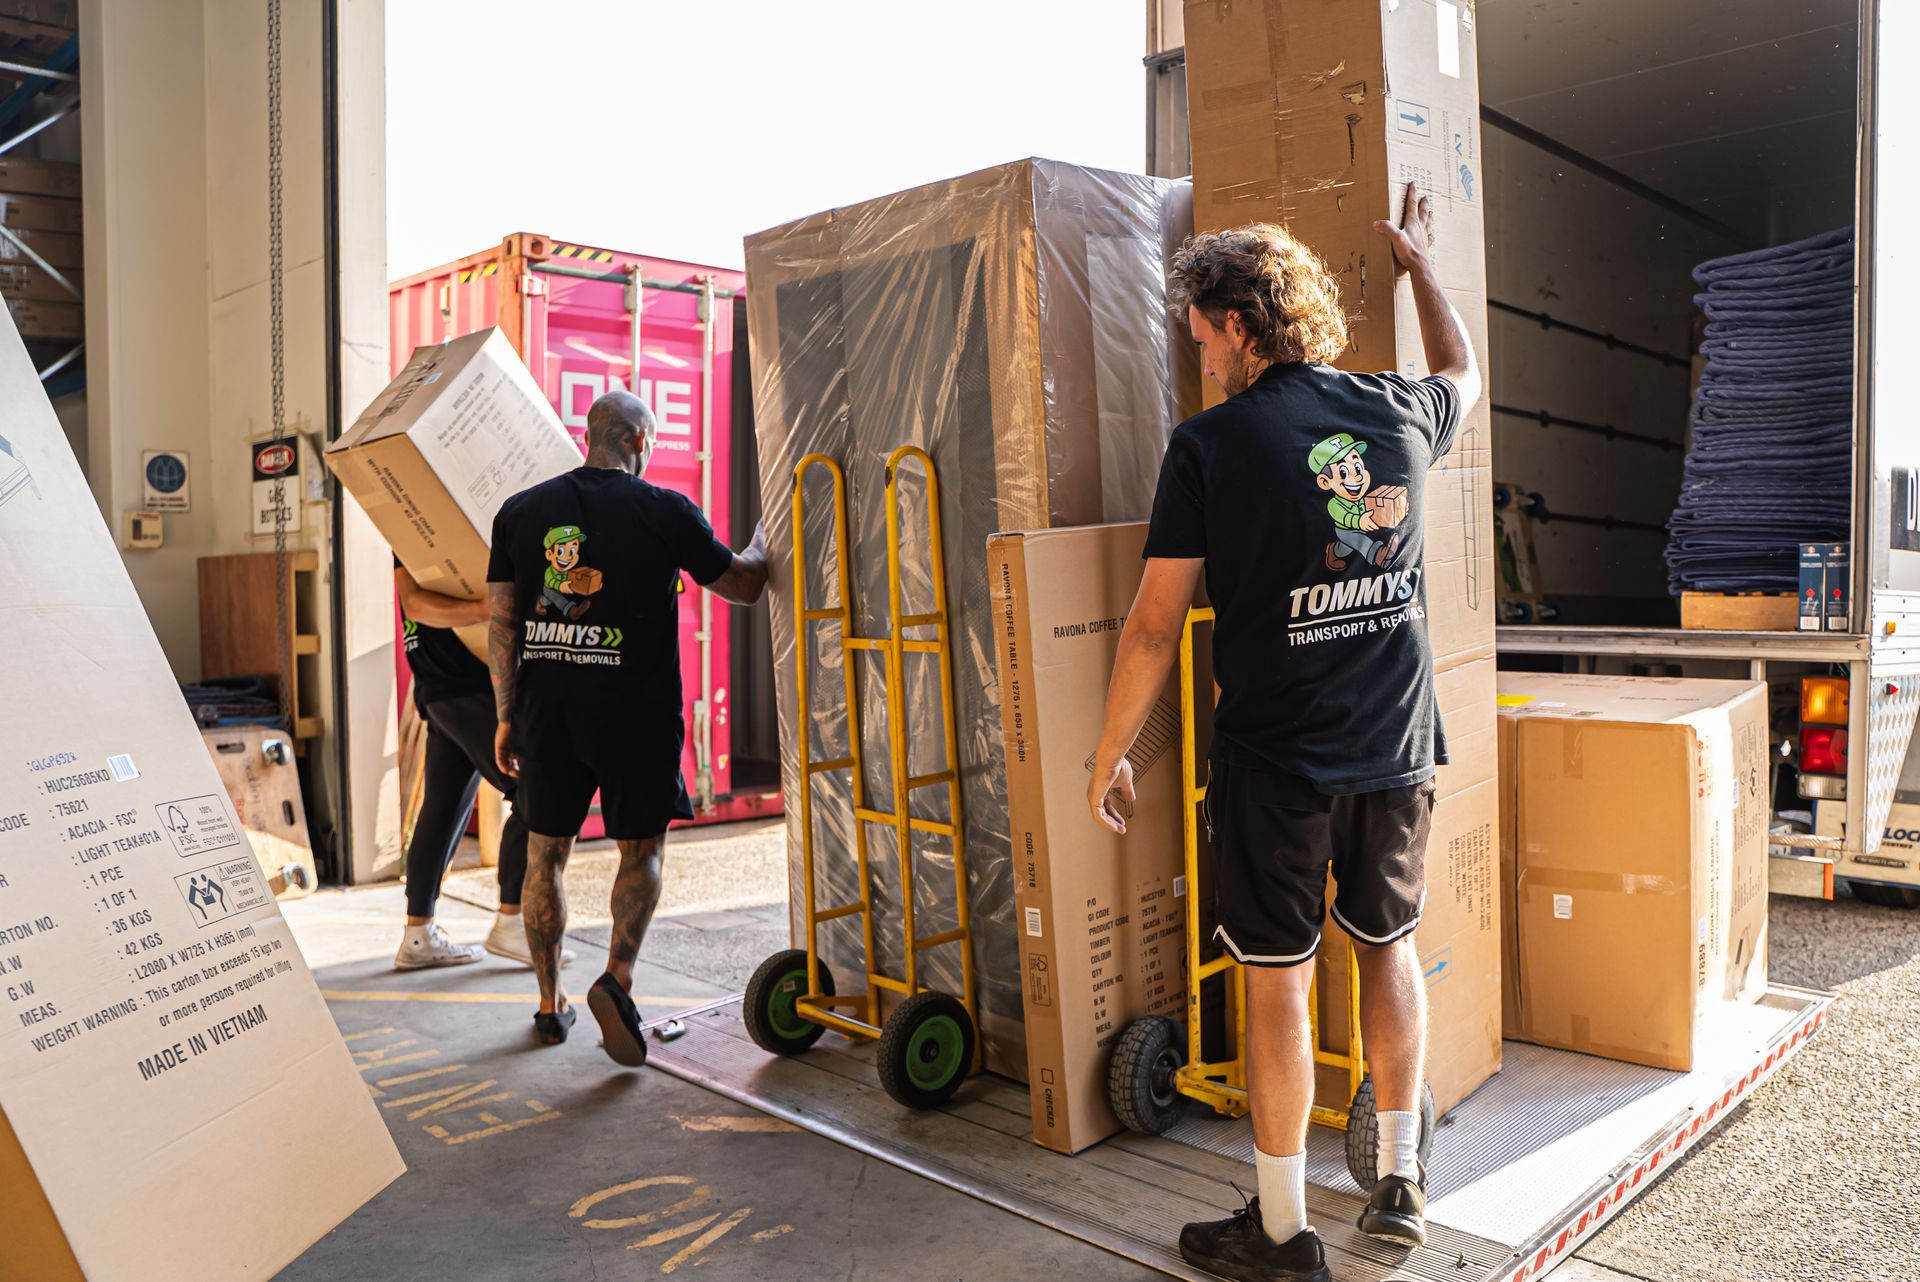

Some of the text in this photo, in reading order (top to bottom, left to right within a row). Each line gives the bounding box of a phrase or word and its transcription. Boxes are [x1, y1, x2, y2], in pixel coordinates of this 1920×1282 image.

[1329, 437, 1343, 448] T
[563, 528, 573, 536] T
[1001, 563, 1012, 601] RAVONA
[1289, 569, 1413, 618] TOMMYS
[1005, 603, 1015, 638] COFFEE
[1054, 622, 1087, 639] RAVONA
[1088, 619, 1118, 634] COFFEE
[1288, 621, 1366, 646] TRANSPORT
[1367, 619, 1379, 632] &
[1008, 641, 1018, 670] TABLE
[1012, 680, 1020, 702] 1275
[55, 799, 90, 817] 75621
[68, 819, 109, 841] ACACIA
[178, 833, 198, 846] FSC
[78, 843, 112, 864] LIGHT
[112, 830, 162, 852] TEAK#01A
[225, 860, 252, 875] WARNING
[1025, 832, 1036, 888] CODE: 75718
[90, 866, 124, 887] 1 PCE
[0, 888, 137, 946] RTON NO. 1 OF 1
[113, 918, 128, 934] 36
[129, 909, 153, 928] KGS
[1095, 907, 1110, 919] CODE
[1089, 920, 1114, 936] PRODUCT
[1115, 915, 1129, 927] CODE
[1090, 936, 1111, 950] TIMBER
[7, 932, 164, 1002] G.W 42 KGS
[1091, 950, 1112, 965] COLOUR
[19, 923, 256, 1028] MEAS. L2080 X W725 X H365 (mm)
[1091, 968, 1103, 979] QTY
[1092, 978, 1115, 992] CARTON
[31, 938, 283, 1052] WEIGHT WARNING This carton box exceeds 15 kgs two
[159, 1014, 171, 1028] or
[172, 1001, 199, 1022] more
[199, 984, 235, 1011] persons
[235, 970, 266, 993] required
[264, 966, 276, 979] for
[137, 1003, 268, 1081] MADE IN VIETNAM
[1044, 1087, 1055, 1128] CHECKED
